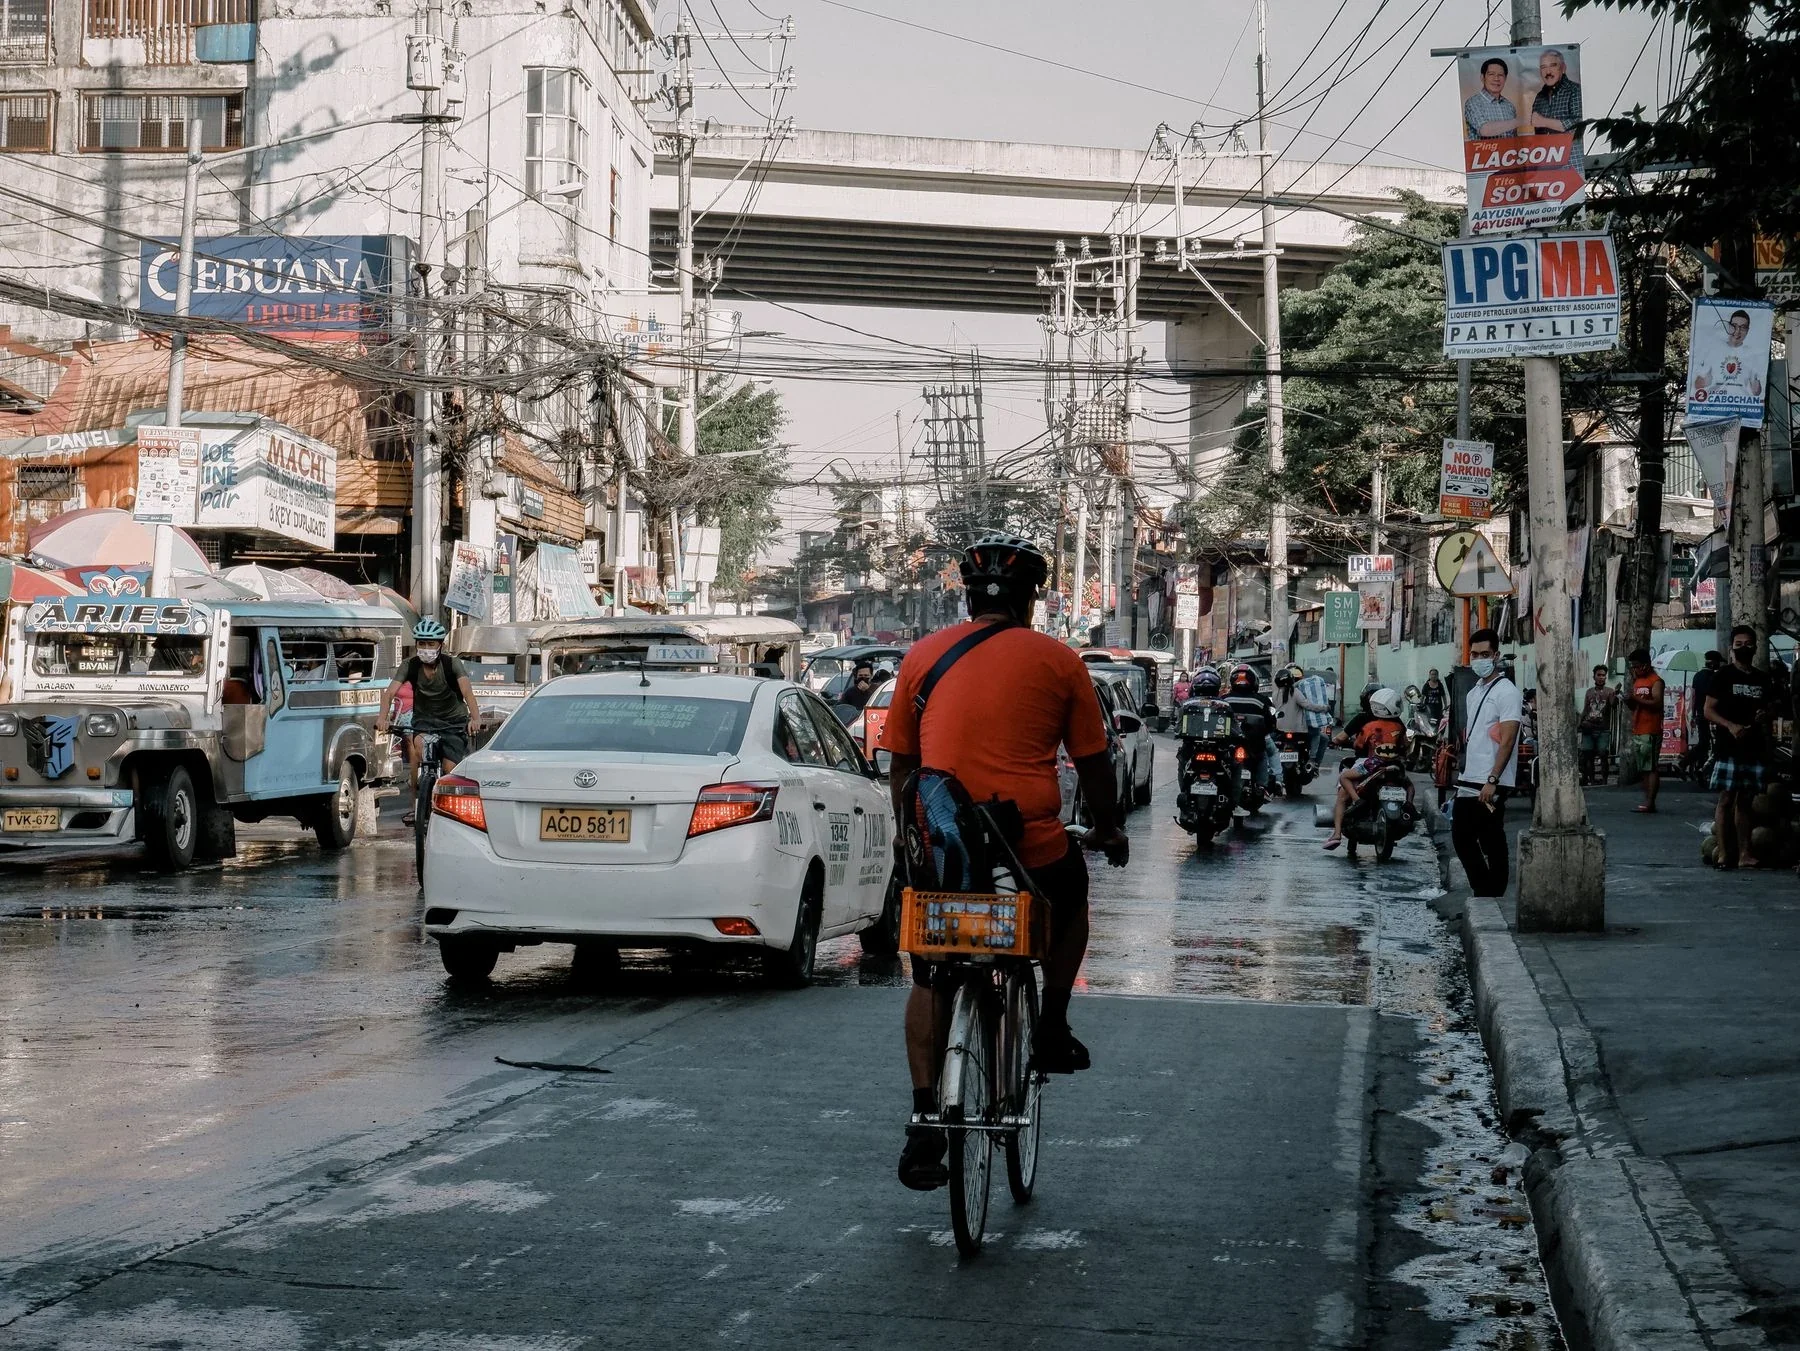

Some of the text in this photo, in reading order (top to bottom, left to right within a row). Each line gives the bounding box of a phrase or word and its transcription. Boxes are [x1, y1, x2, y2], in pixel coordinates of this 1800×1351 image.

[1473, 142, 1498, 151] Ping
[1471, 146, 1566, 170] LACSON
[1494, 177, 1515, 186] Tito
[1490, 181, 1566, 204] SOTTO
[1472, 207, 1525, 220] AAYUSIN
[1472, 217, 1525, 232] AAYUSIN
[148, 244, 380, 300] CEBUANA
[1450, 240, 1616, 304] LPG MA
[1450, 302, 1616, 319] LIQUEFIED PETROLEUM GAS MARKETERS' ASSOCIATION
[613, 332, 673, 343] Generika
[1696, 390, 1705, 400] 2
[1708, 395, 1760, 404] CABOCHAN
[46, 430, 118, 450] DANIEL
[142, 440, 178, 448] THIS WAY
[202, 443, 237, 462] OE
[267, 434, 326, 484] MACHI
[1454, 452, 1471, 464] NO
[1445, 464, 1492, 478] PARKING
[200, 487, 240, 512] pair
[275, 504, 291, 528] KEY
[294, 512, 326, 538] DUPLICATE
[1350, 557, 1392, 571] LPG MA
[1334, 597, 1353, 609] SM
[36, 604, 192, 625] ARIES
[1334, 610, 1353, 618] CITY
[82, 648, 114, 656] LETRE
[659, 648, 701, 659] TAXI
[79, 662, 109, 670] BAYAN
[36, 682, 75, 690] MALABON
[7, 814, 56, 825] TVK-672
[546, 816, 625, 834] ACD 5811
[831, 825, 848, 842] 1342
